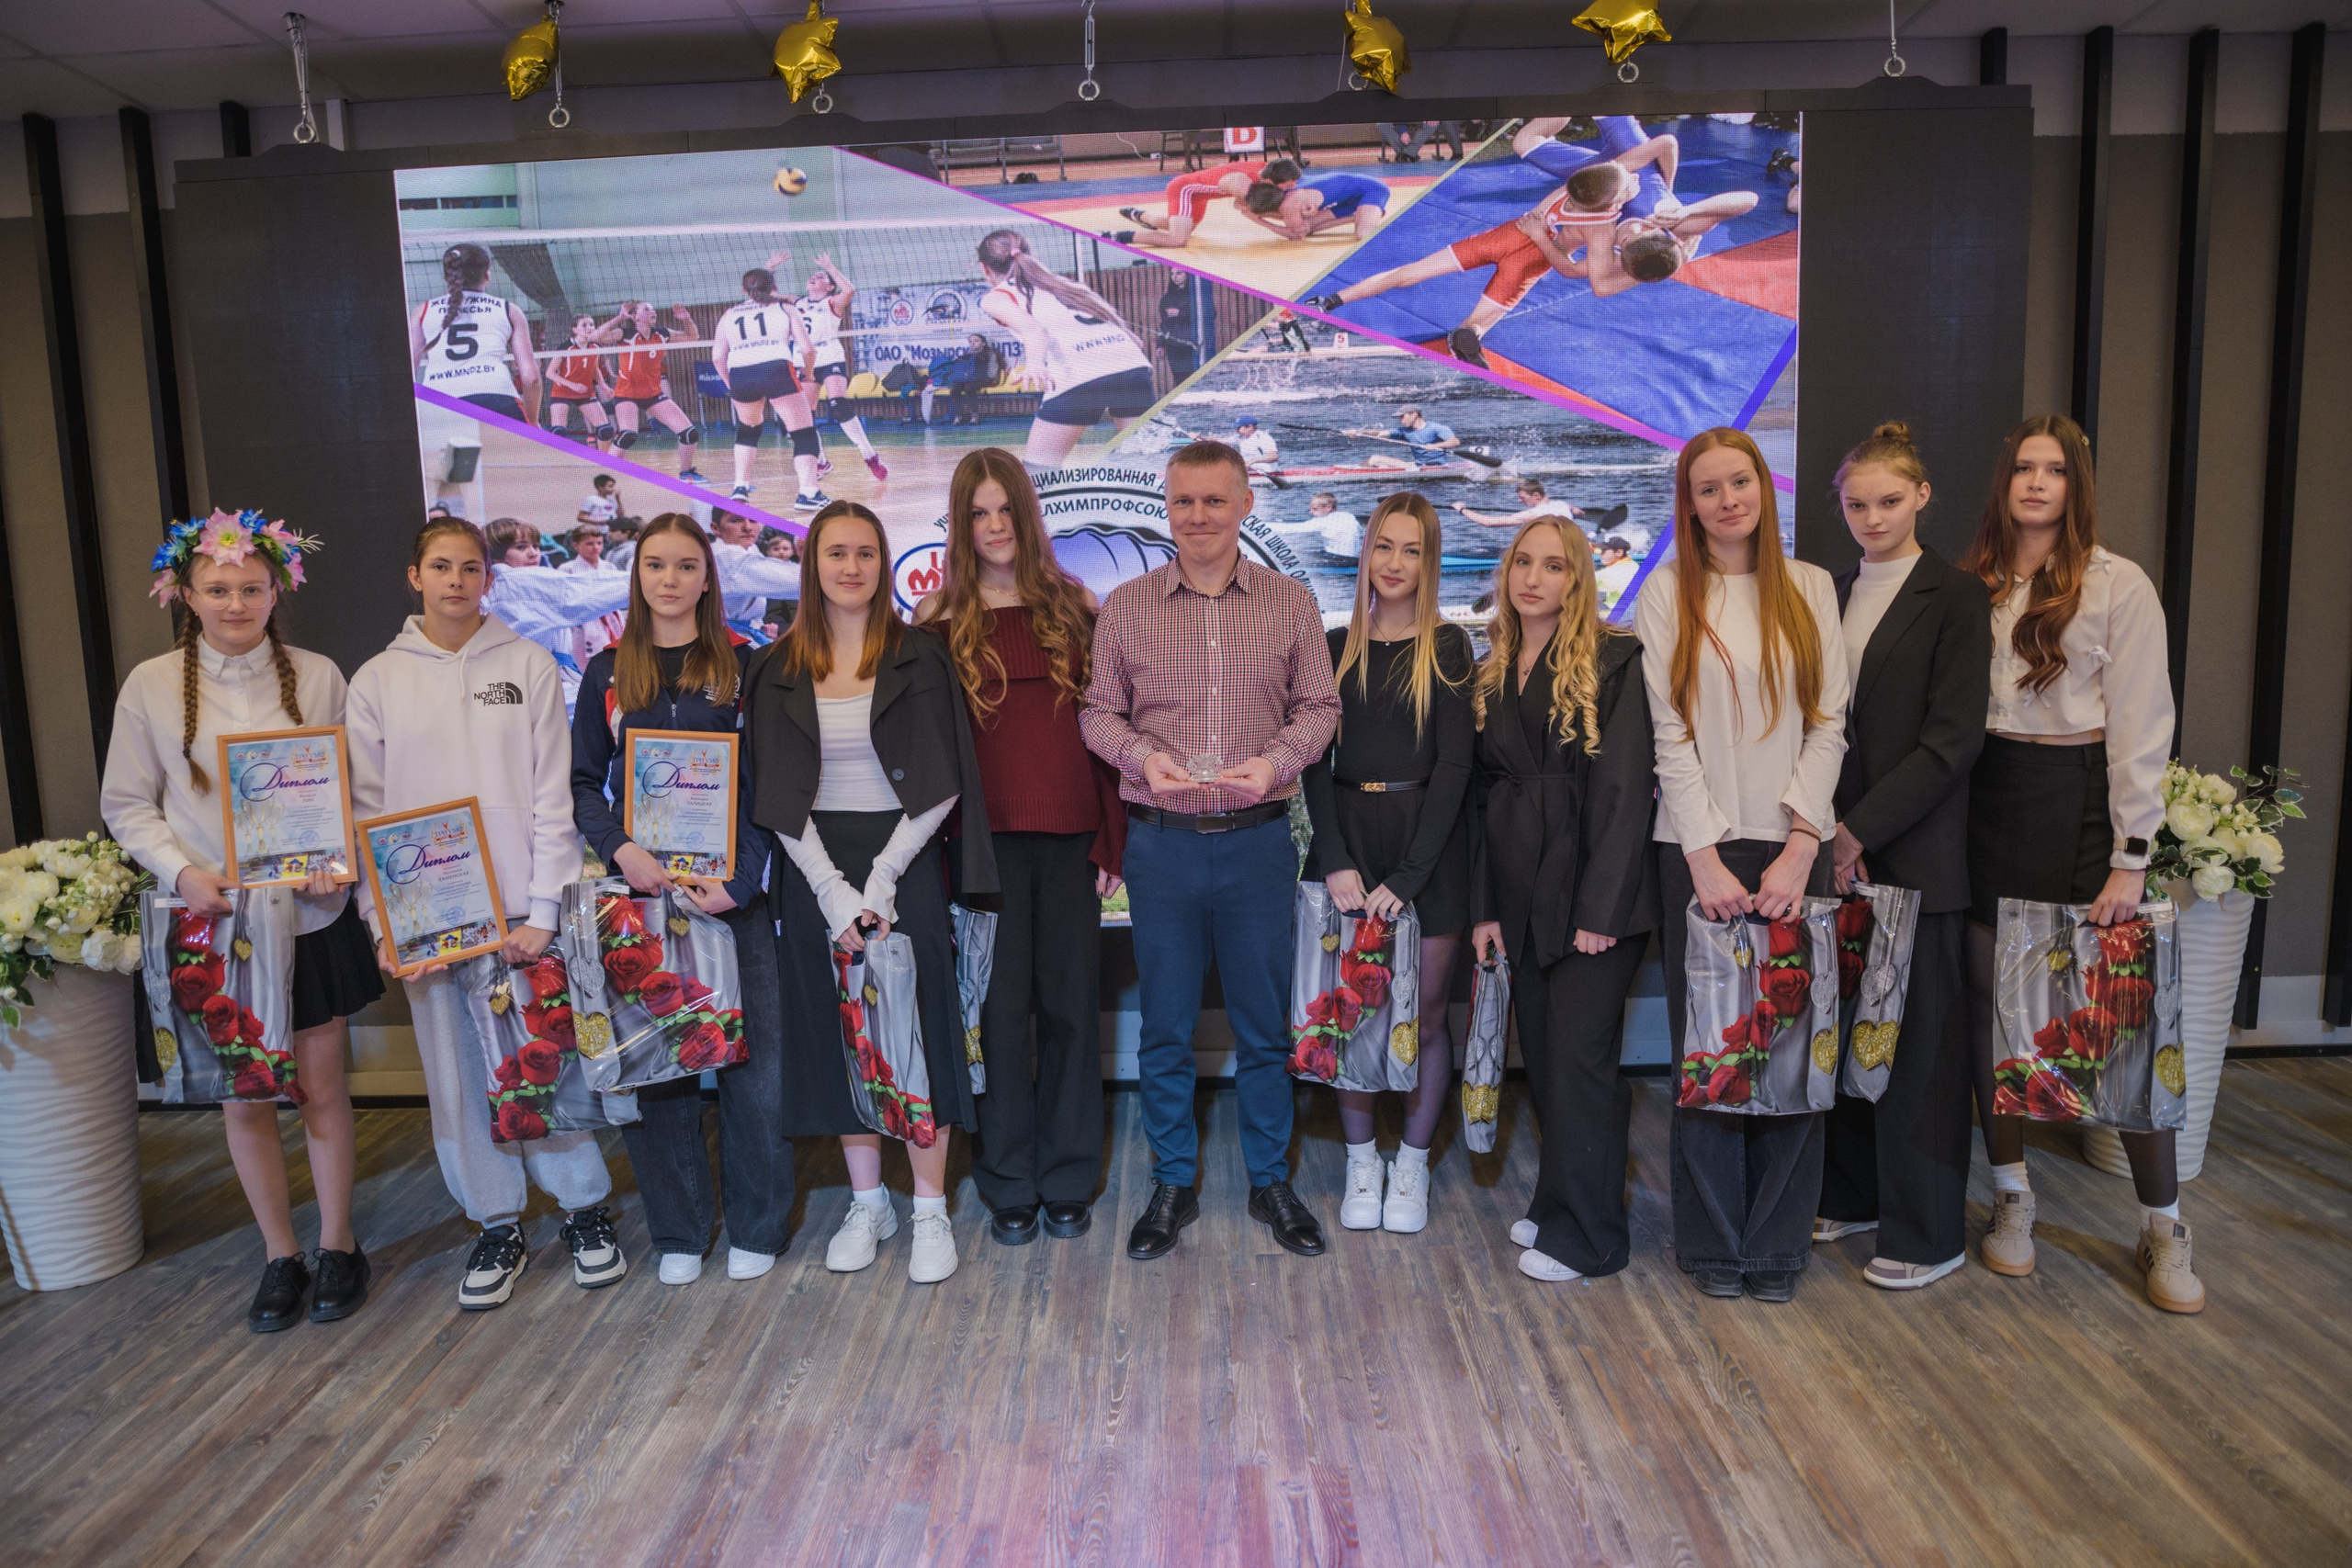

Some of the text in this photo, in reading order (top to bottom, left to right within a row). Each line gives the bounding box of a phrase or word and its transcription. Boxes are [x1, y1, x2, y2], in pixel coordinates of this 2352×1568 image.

[734, 311, 767, 340] 11
[445, 323, 479, 361] 5
[874, 344, 901, 361] ОАО
[582, 357, 588, 368] 1
[1031, 468, 1157, 491] ЦИАЛИЗИРОВАННАЯ
[1264, 535, 1300, 570] ШКОЛА
[1042, 498, 1169, 520] ЛХИМПРОФСОЮ
[473, 689, 505, 701] NORTH
[487, 682, 505, 691] THE
[483, 696, 506, 706] FACE
[240, 762, 330, 802] Диплом
[642, 761, 720, 799] Диплом
[386, 844, 471, 885] Диплом
